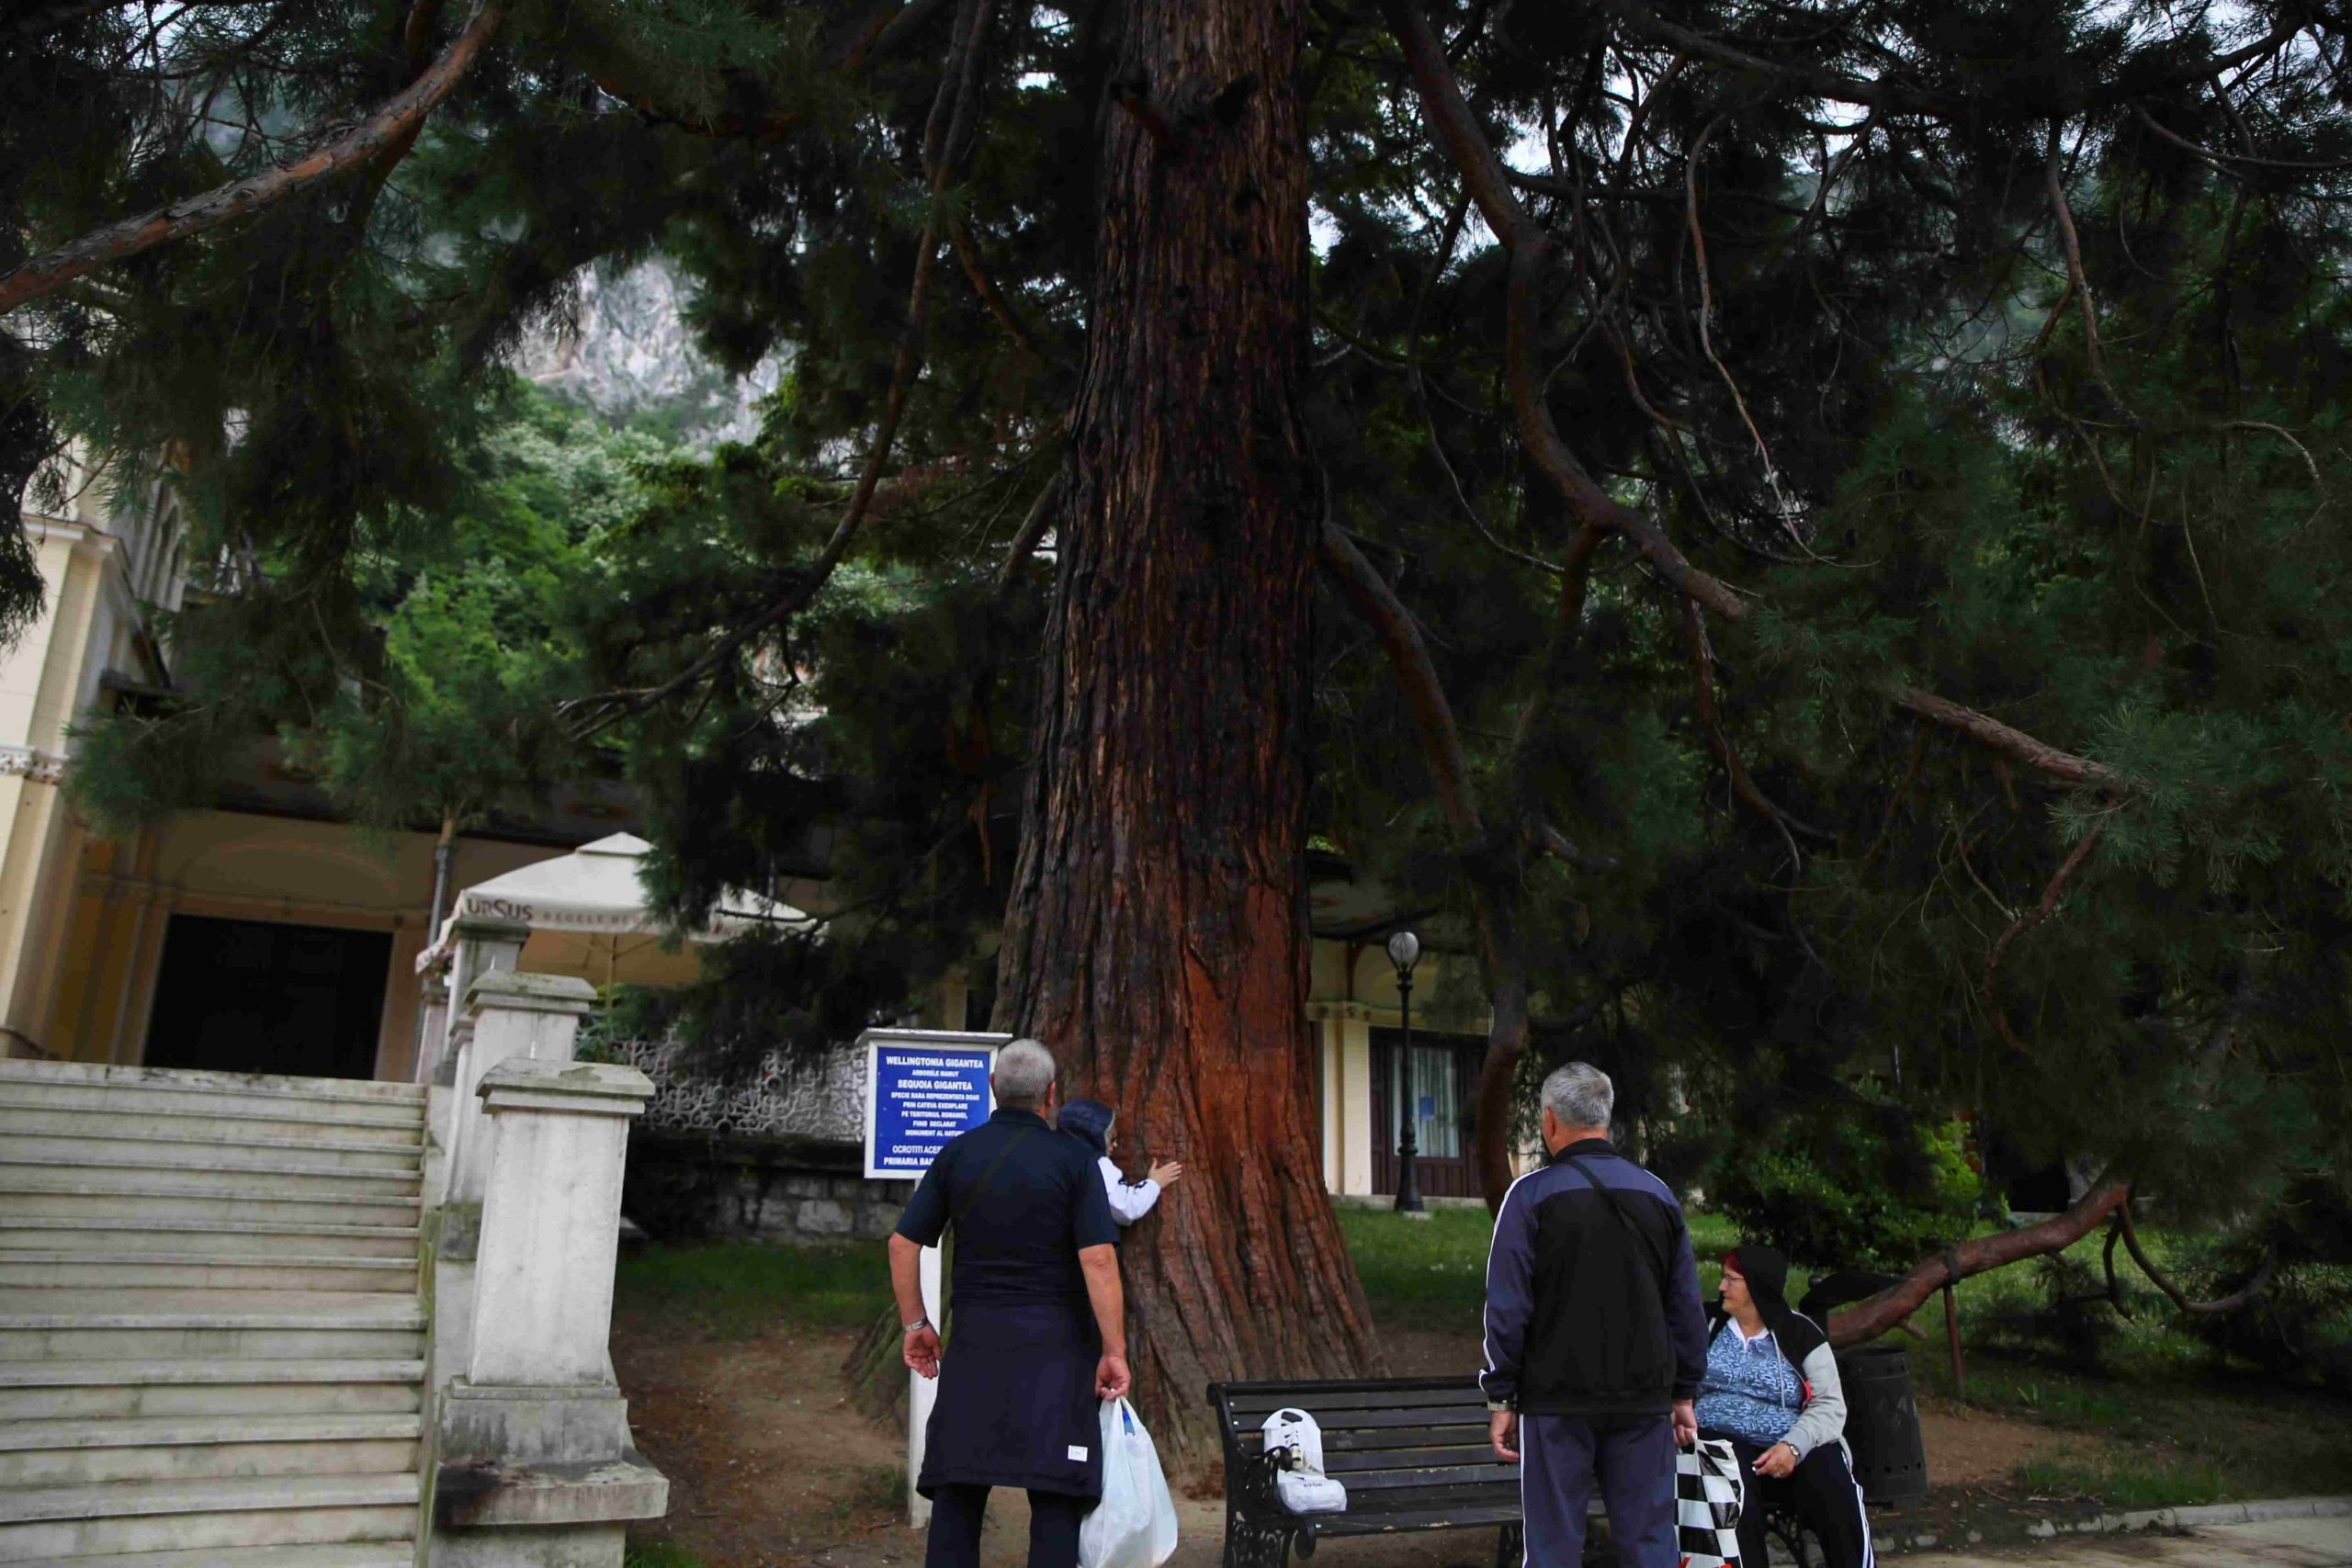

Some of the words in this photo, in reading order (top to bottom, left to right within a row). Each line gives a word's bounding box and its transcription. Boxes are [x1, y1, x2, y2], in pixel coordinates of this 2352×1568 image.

[467, 898, 533, 920] URSUS
[887, 1056, 944, 1066] WELLINGTONIA
[945, 1059, 983, 1067] GIGANTEA
[898, 1079, 933, 1089] SEQUOIA
[934, 1081, 972, 1090] GIGANTEA
[892, 1145, 923, 1154] OCROTITI
[884, 1156, 918, 1165] PRIMARIA
